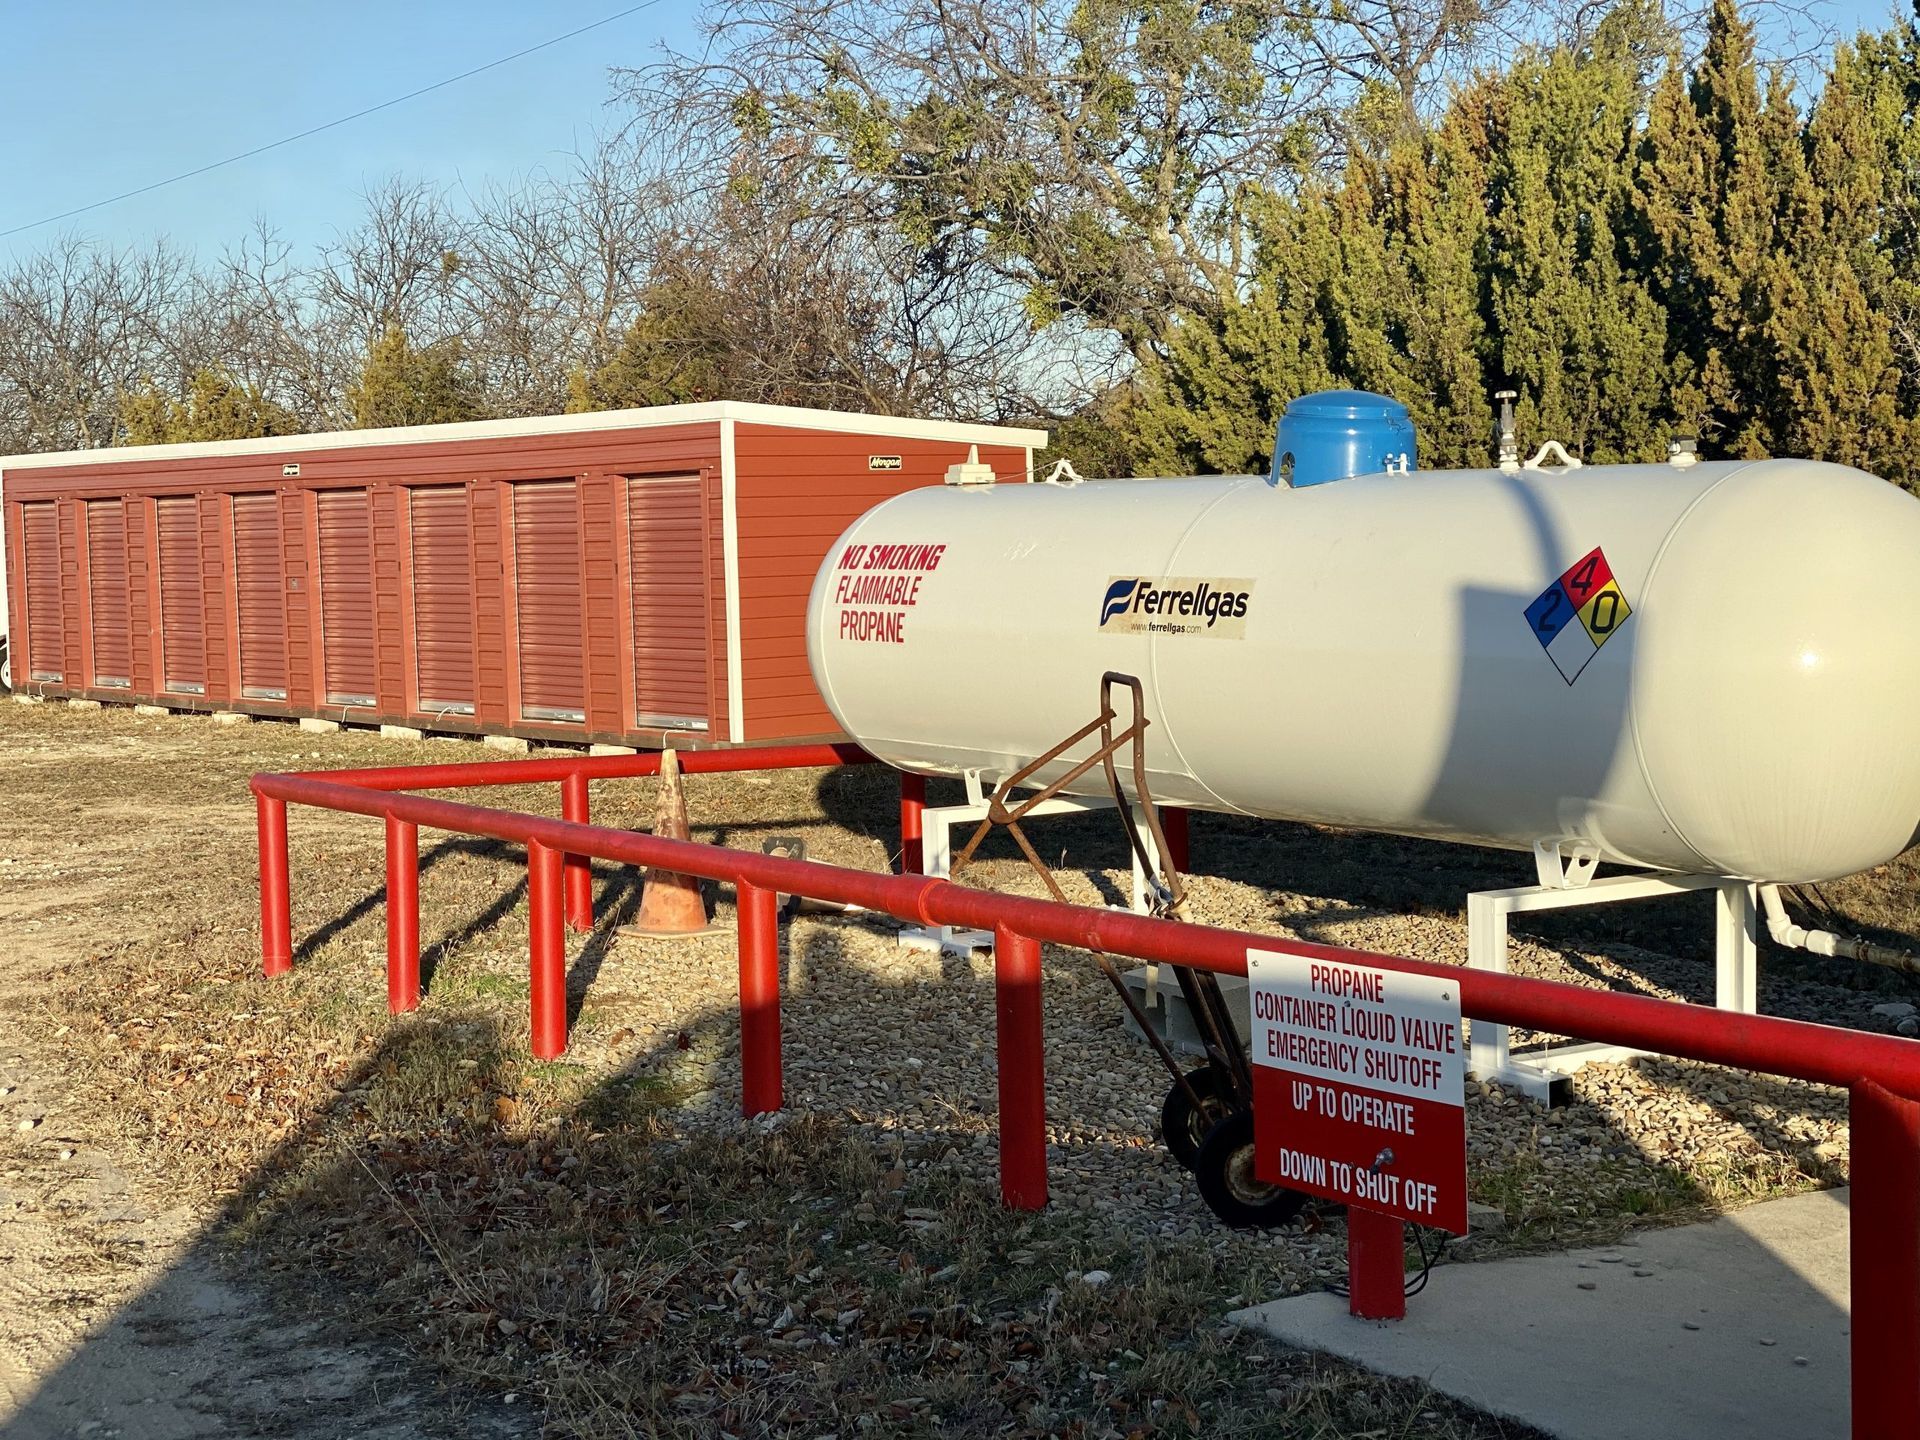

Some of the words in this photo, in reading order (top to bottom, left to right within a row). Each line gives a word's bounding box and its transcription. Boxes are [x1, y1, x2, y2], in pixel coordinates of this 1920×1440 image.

[870, 457, 900, 468] Morgan
[838, 545, 866, 570] NO
[863, 545, 946, 571] SMOKING
[1570, 556, 1599, 596] 4
[836, 575, 922, 605] FLAMMABLE
[1132, 581, 1250, 628] Ferrellgas
[1538, 589, 1562, 632] 2
[840, 610, 905, 643] PROPANE
[1131, 621, 1202, 635] www.ferrellgas.com
[1590, 590, 1620, 634] 0
[1311, 964, 1385, 1004] PROPANE
[1255, 990, 1337, 1033] CONTAINER
[1341, 1006, 1396, 1043] LIQUID
[1401, 1017, 1456, 1054] VALVE
[1267, 1029, 1359, 1074] EMERGENCY
[1364, 1048, 1442, 1090] SHUTOFF
[1292, 1080, 1312, 1112] UP
[1316, 1086, 1337, 1118] TO
[1341, 1091, 1415, 1136] OPERATE
[1280, 1148, 1326, 1187] DOWN
[1330, 1161, 1351, 1195] TO
[1356, 1167, 1399, 1206] SHUT
[1405, 1179, 1437, 1214] OFF
